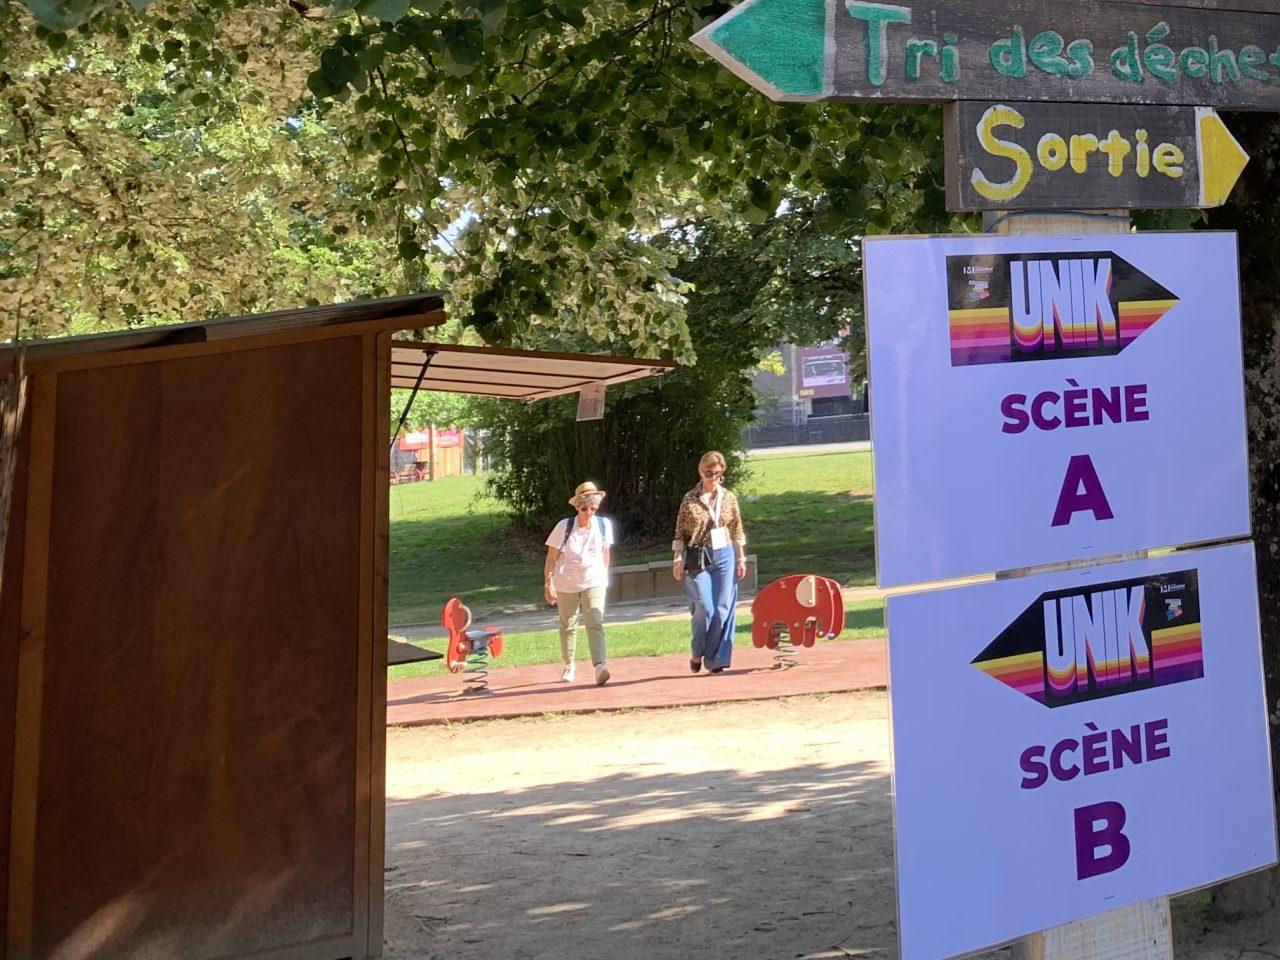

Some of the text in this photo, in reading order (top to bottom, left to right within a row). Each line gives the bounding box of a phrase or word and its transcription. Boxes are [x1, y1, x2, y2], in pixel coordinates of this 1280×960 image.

[845, 0, 961, 86] Tri
[990, 24, 1095, 80] des
[970, 105, 1185, 201] Sortie
[1000, 378, 1150, 435] SCÈNE
[1050, 454, 1115, 527] A
[1019, 718, 1172, 790] SCÈNE
[1073, 800, 1131, 881] B
